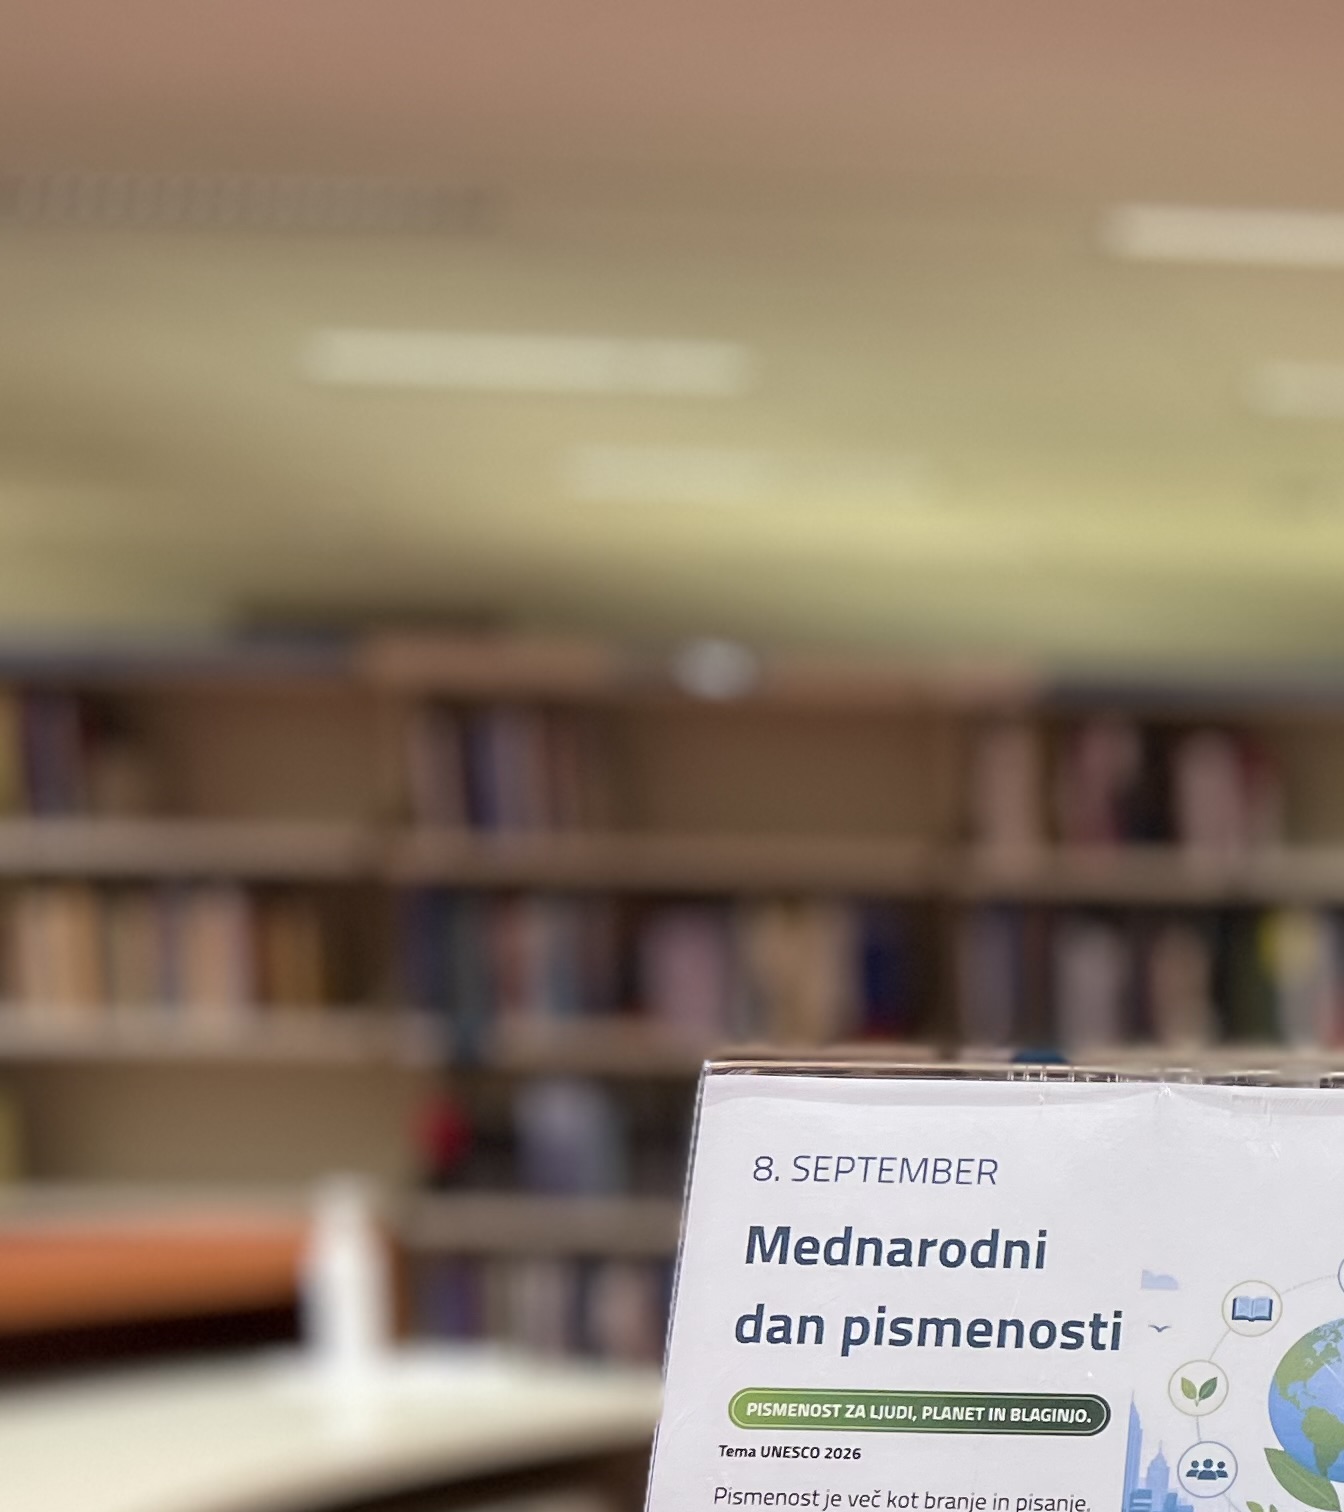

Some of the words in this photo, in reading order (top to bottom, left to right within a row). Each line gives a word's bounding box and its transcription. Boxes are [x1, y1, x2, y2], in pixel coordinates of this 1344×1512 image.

[753, 1155, 779, 1182] 8.
[791, 1155, 998, 1185] SEPTEMBER
[745, 1225, 1047, 1269] Mednarodni
[735, 1303, 824, 1345] dan
[840, 1305, 1122, 1357] pismenosti
[746, 1402, 842, 1418] PISMENOST
[844, 1404, 866, 1418] ZA
[869, 1404, 917, 1422] LJUDI,
[921, 1405, 986, 1421] PLANET
[988, 1407, 1006, 1421] IN
[1009, 1407, 1092, 1423] BLAGINJO.
[718, 1444, 756, 1458] Tema
[760, 1445, 820, 1459] UNESCO
[823, 1447, 861, 1460] 2026
[713, 1486, 820, 1507] Pismenost
[821, 1489, 842, 1511] je
[847, 1489, 881, 1508] več
[886, 1490, 919, 1509] kot
[992, 1492, 1009, 1510] in
